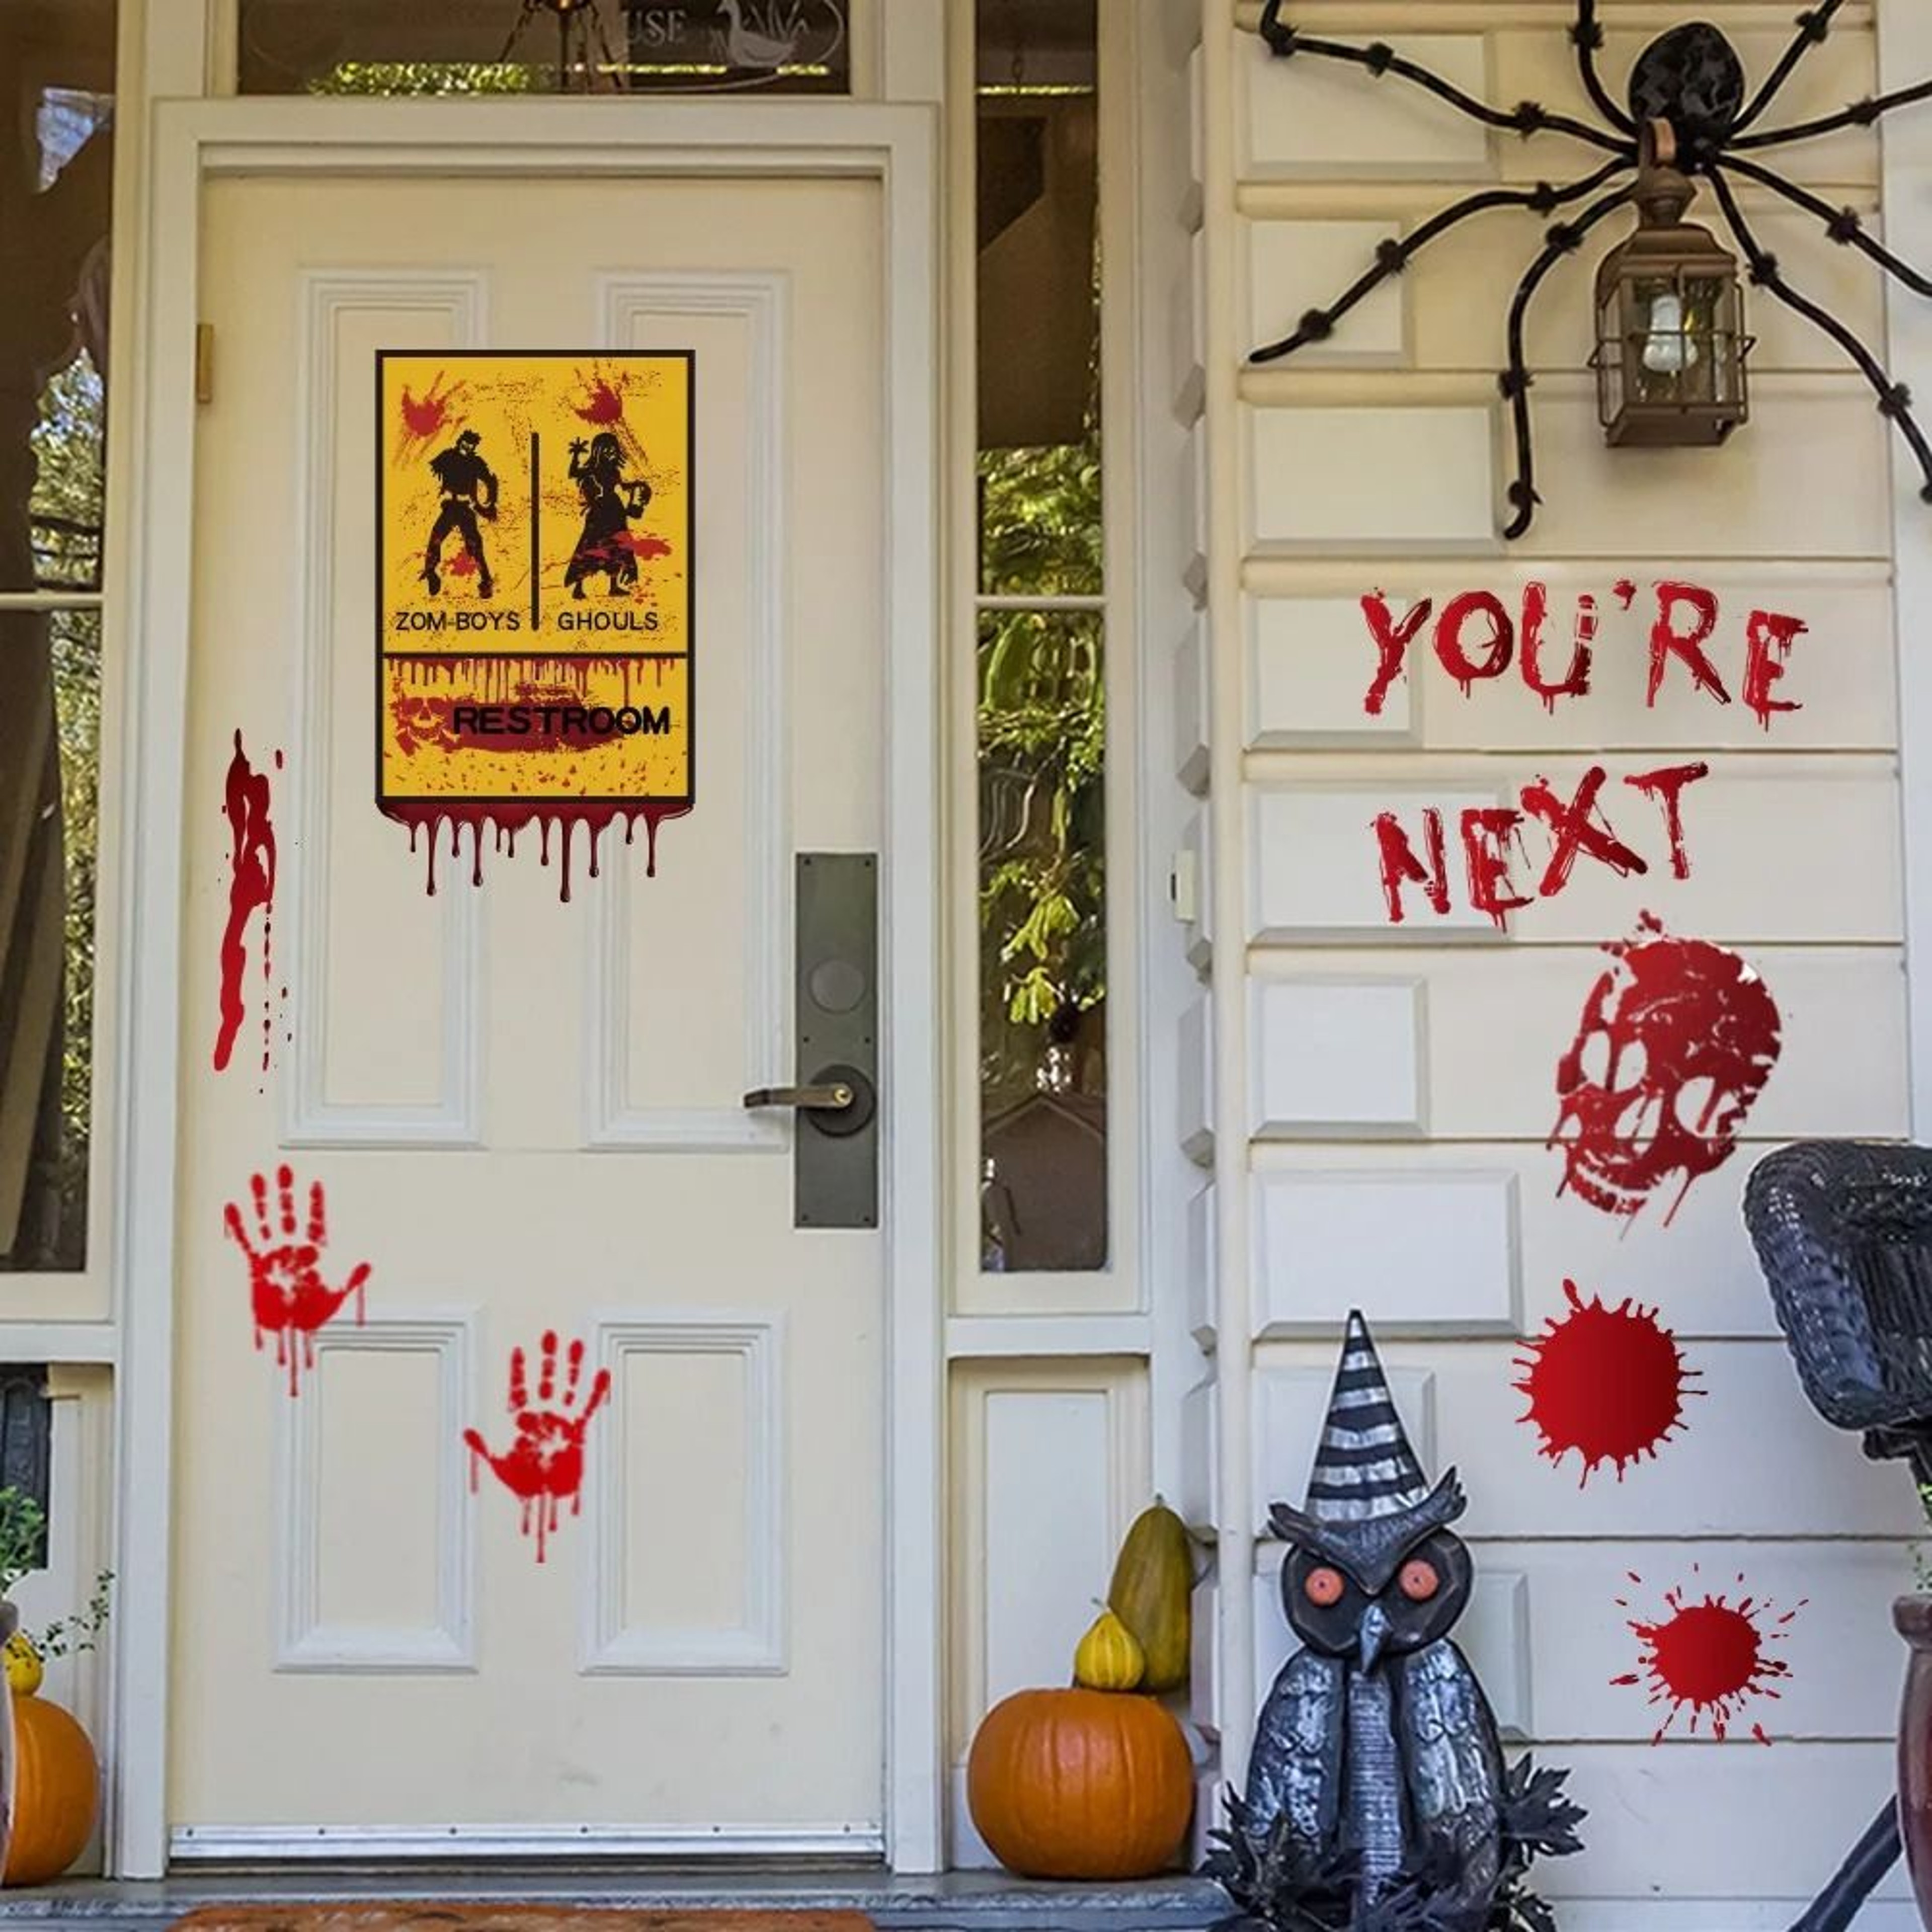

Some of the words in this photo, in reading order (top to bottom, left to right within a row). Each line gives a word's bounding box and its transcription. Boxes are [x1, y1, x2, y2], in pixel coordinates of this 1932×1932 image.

[395, 610, 520, 631] ZOM-BOYS
[557, 611, 658, 631] GHOULS
[1360, 579, 1808, 732] YOU'RE
[453, 705, 670, 735] RESTROOM
[1370, 762, 1708, 933] NEXT
